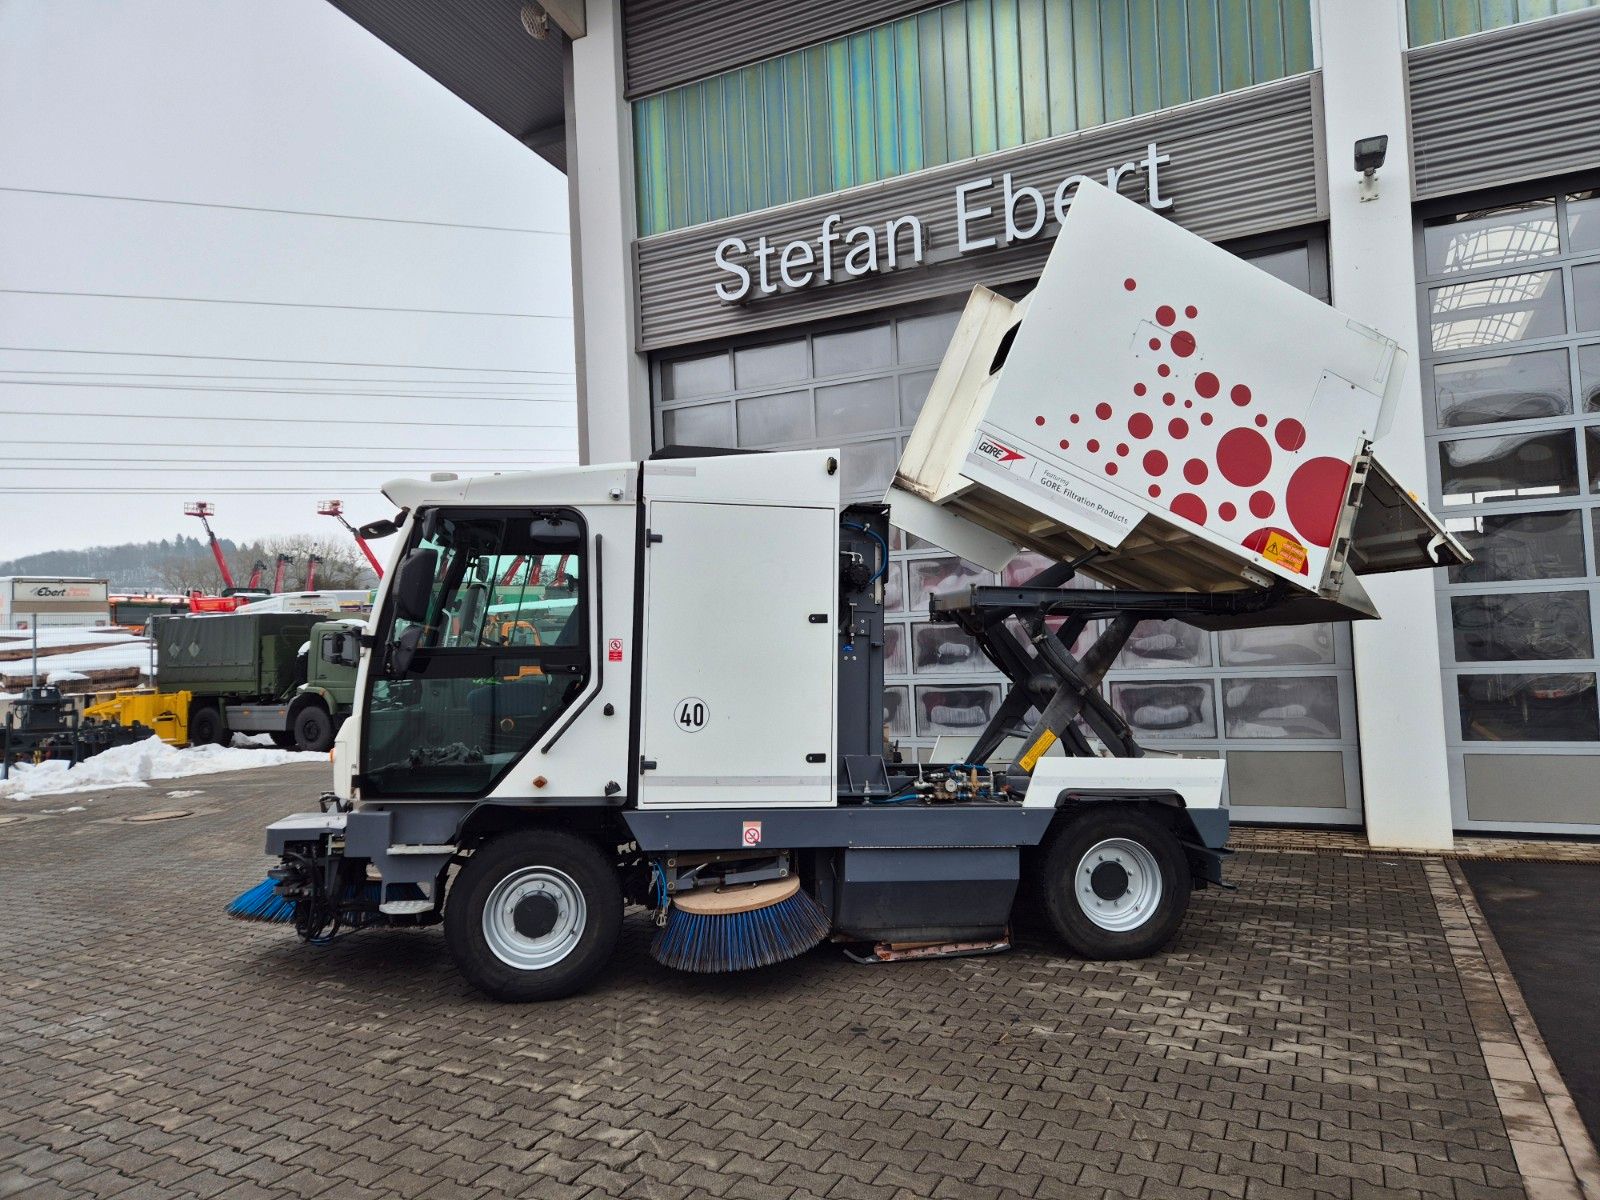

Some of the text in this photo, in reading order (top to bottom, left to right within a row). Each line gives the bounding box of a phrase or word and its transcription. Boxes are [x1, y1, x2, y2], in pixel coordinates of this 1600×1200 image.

[714, 213, 923, 301] Stefan
[979, 441, 1003, 459] GORE
[1043, 469, 1070, 487] Featuring
[1063, 488, 1096, 508] Filtration
[1096, 504, 1129, 525] Products
[37, 587, 66, 597] Ebert
[680, 703, 704, 727] 40
